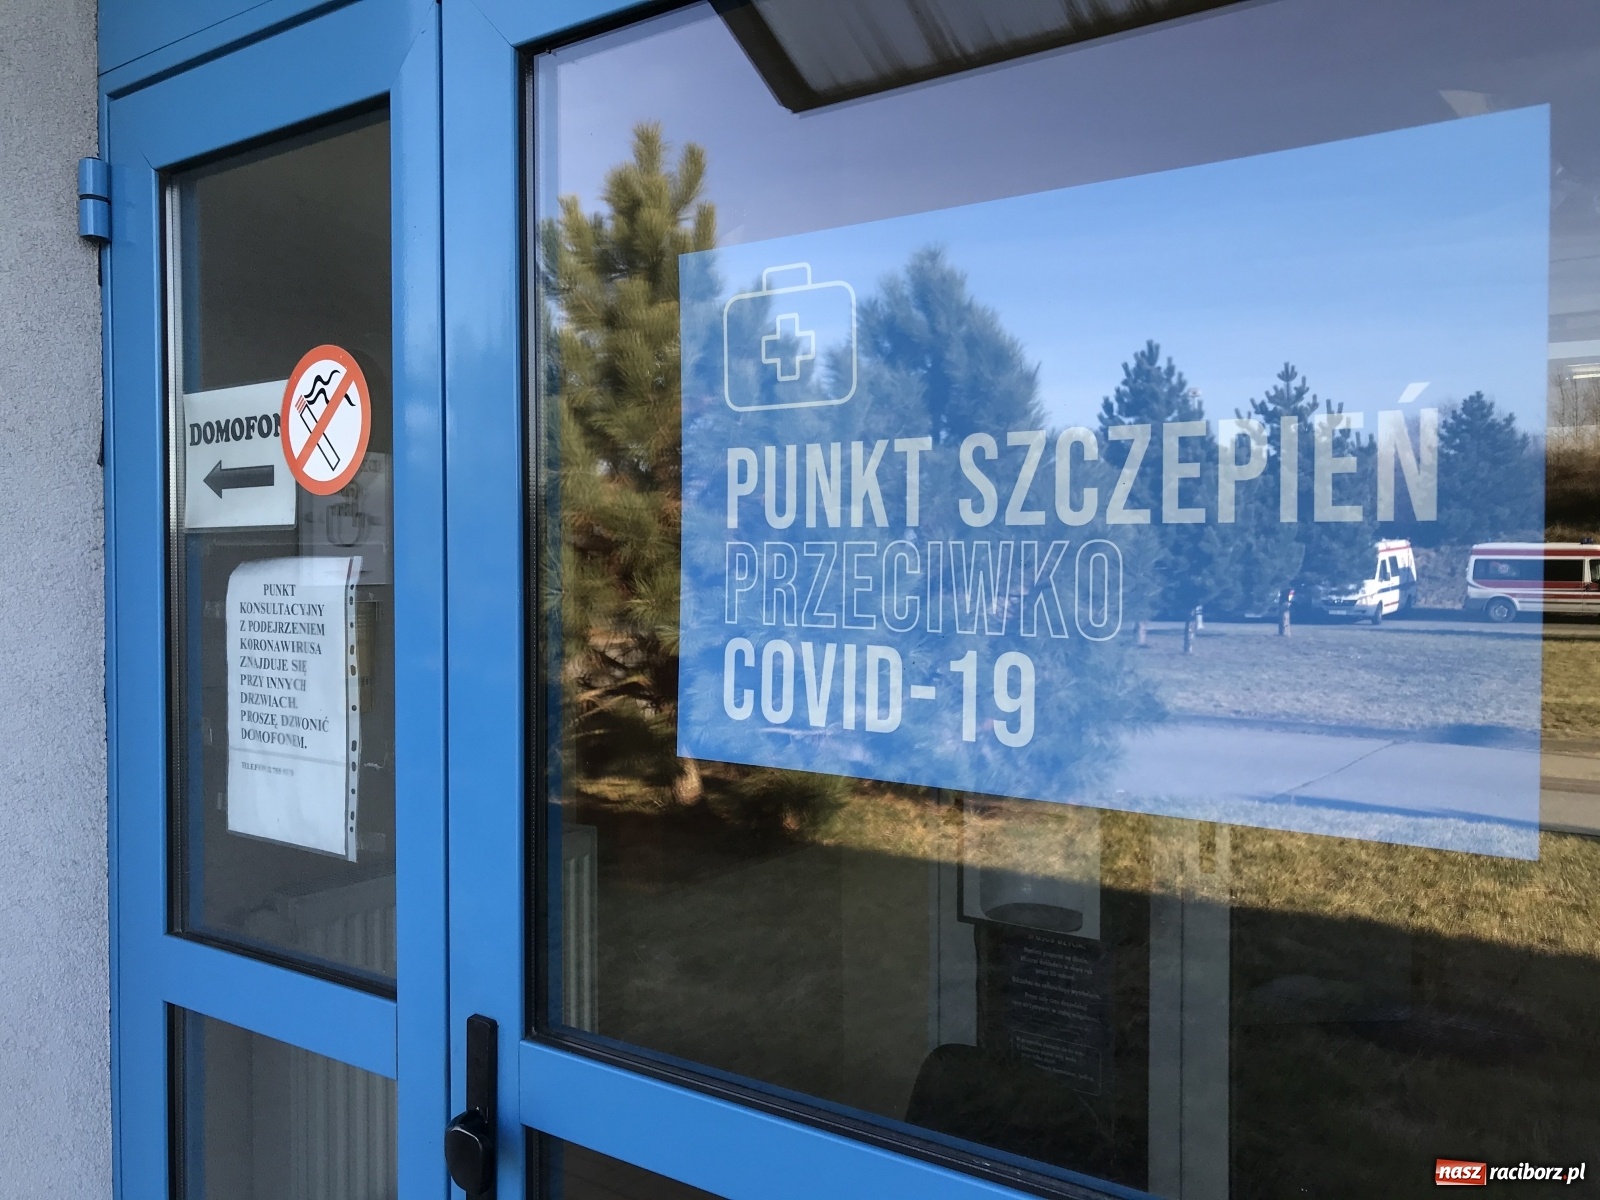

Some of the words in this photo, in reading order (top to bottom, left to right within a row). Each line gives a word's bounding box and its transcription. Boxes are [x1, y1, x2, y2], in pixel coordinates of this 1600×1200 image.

[726, 436, 933, 530] PUNKT
[958, 382, 1439, 528] SZCZEPIEŃ
[263, 584, 297, 597] PUNKT
[724, 538, 1123, 642] PRZECIWKO
[240, 602, 325, 617] KONSULTACYJNY
[240, 620, 246, 632] Z
[248, 620, 326, 636] PODEJRZENIEM
[240, 638, 322, 655] KORONAWIRUSA
[240, 656, 289, 671] ZNAJDUJE
[291, 659, 307, 676] SIĘ
[240, 674, 264, 688] PRZY
[266, 676, 307, 692] INNYCH
[723, 637, 1036, 748] COVID-19
[240, 709, 278, 729] PROSZĘ
[281, 714, 330, 733] DZWONIĆ
[241, 728, 308, 749] DOMOFONEM.
